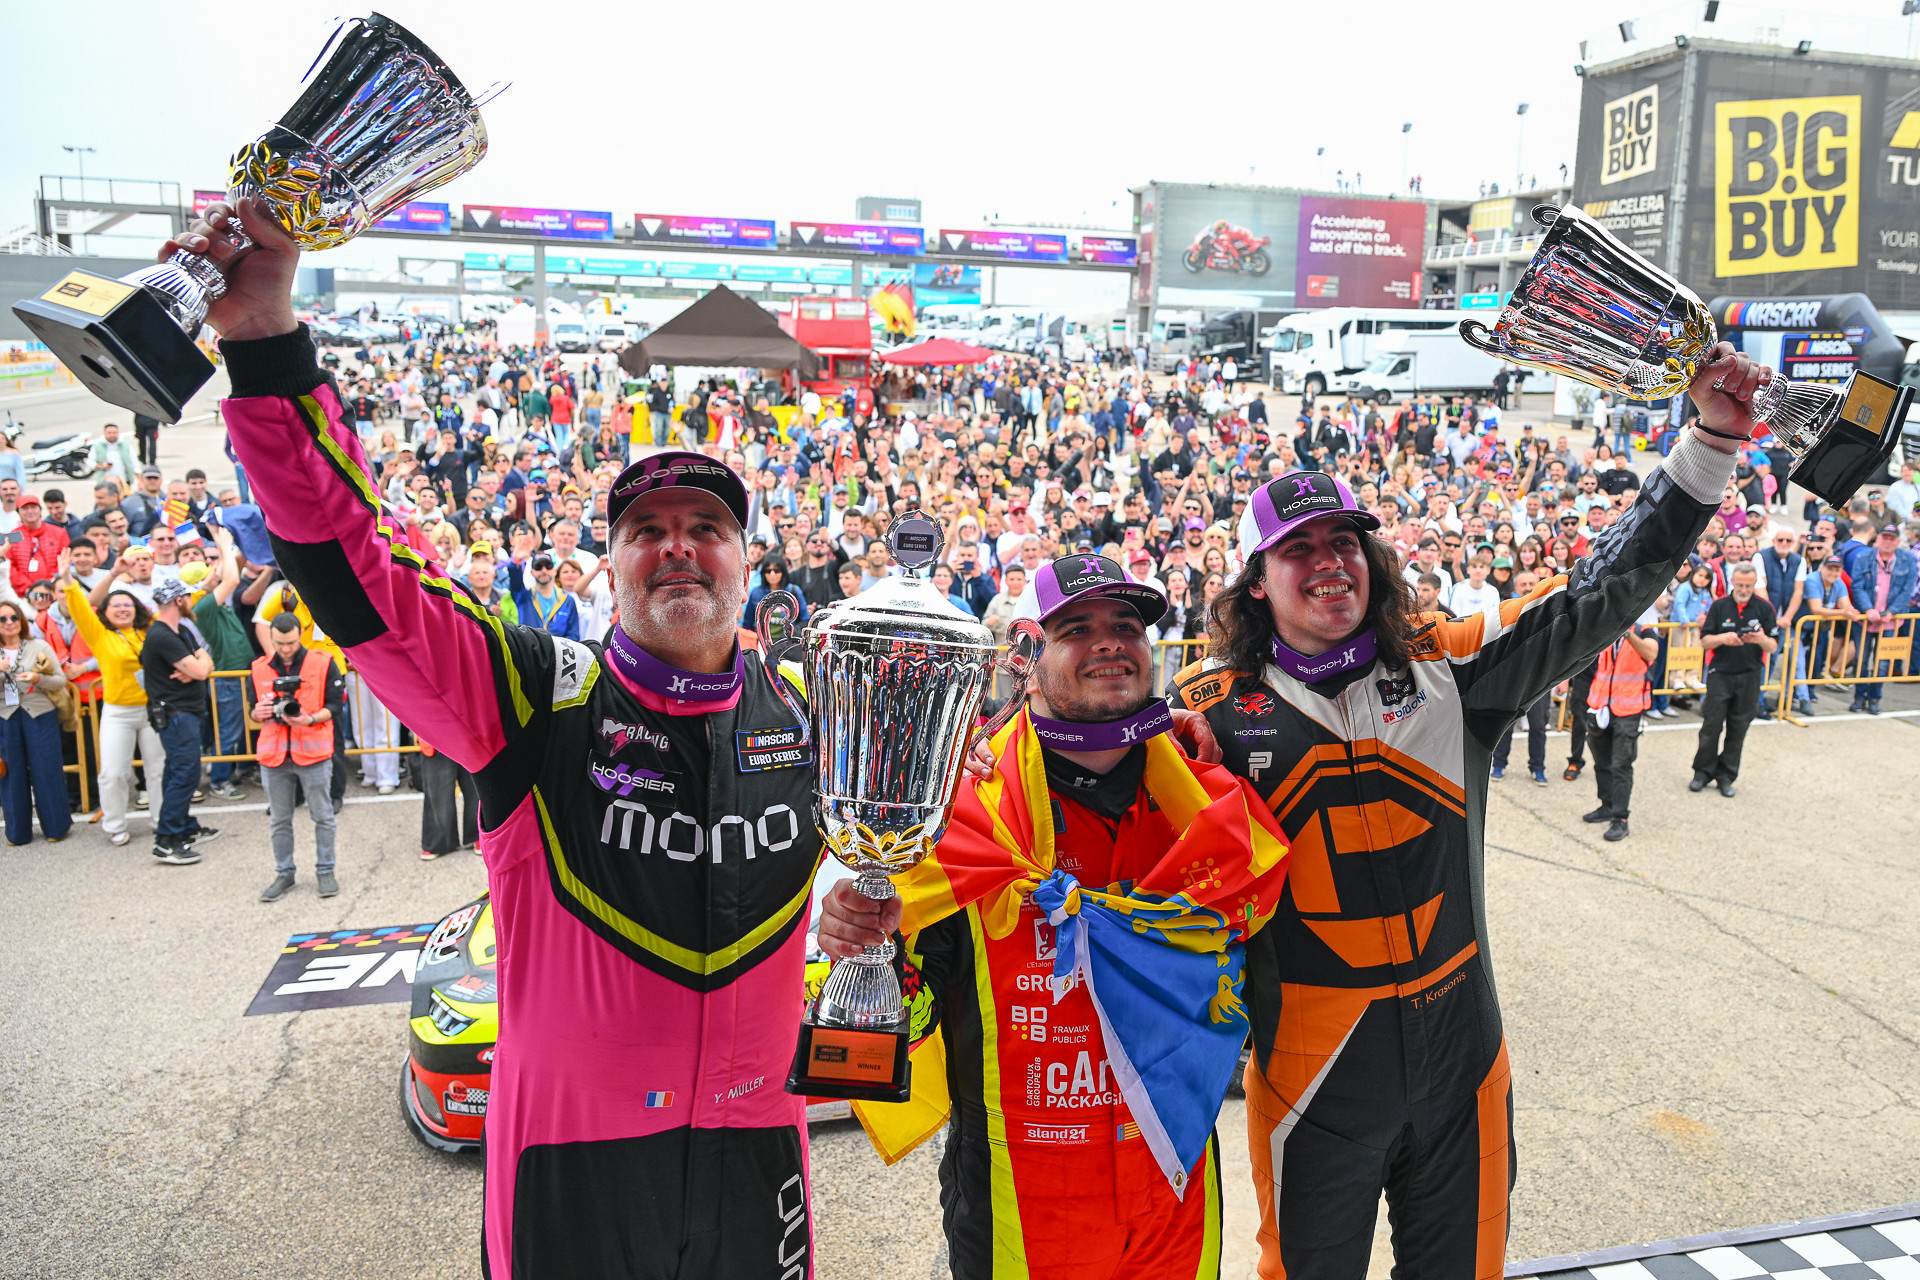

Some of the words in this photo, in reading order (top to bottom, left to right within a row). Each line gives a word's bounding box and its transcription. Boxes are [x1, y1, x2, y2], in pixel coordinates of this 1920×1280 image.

[1608, 136, 1651, 175] BUY
[1729, 111, 1848, 197] B!G
[1608, 194, 1665, 215] ACELERA
[1310, 213, 1386, 232] Accelerating
[1630, 211, 1664, 229] ONLINE
[1729, 195, 1847, 262] BUY
[1310, 227, 1373, 241] innovation
[1374, 232, 1390, 243] on
[1880, 229, 1919, 248] YOUR
[1309, 241, 1333, 254] and
[1334, 241, 1353, 254] off
[1353, 243, 1373, 255] the
[1374, 243, 1407, 257] track.
[1745, 301, 1822, 328] NASCAR
[1792, 363, 1821, 377] EURO
[1821, 363, 1854, 378] SERIES
[614, 465, 728, 496] HOOSIER
[1282, 496, 1338, 514] HOOSIER
[1296, 659, 1342, 675] HOOSIER
[1191, 681, 1222, 703] OMP
[758, 732, 795, 747] NASCAR
[1037, 729, 1084, 742] HOOSIER
[748, 754, 773, 766] EURO
[772, 749, 802, 763] SERIES
[592, 762, 675, 794] HOOSIER
[601, 799, 799, 863] mono
[1411, 998, 1423, 1009] T.
[1426, 971, 1467, 1004] Krasonis
[1052, 1035, 1087, 1043] PUBLICS
[1053, 1025, 1090, 1033] TRAVAUX
[714, 1093, 725, 1104] Y.
[728, 1076, 765, 1099] MULLER
[1026, 1063, 1034, 1106] CARTOLUX
[1033, 1073, 1041, 1106] GROUPE
